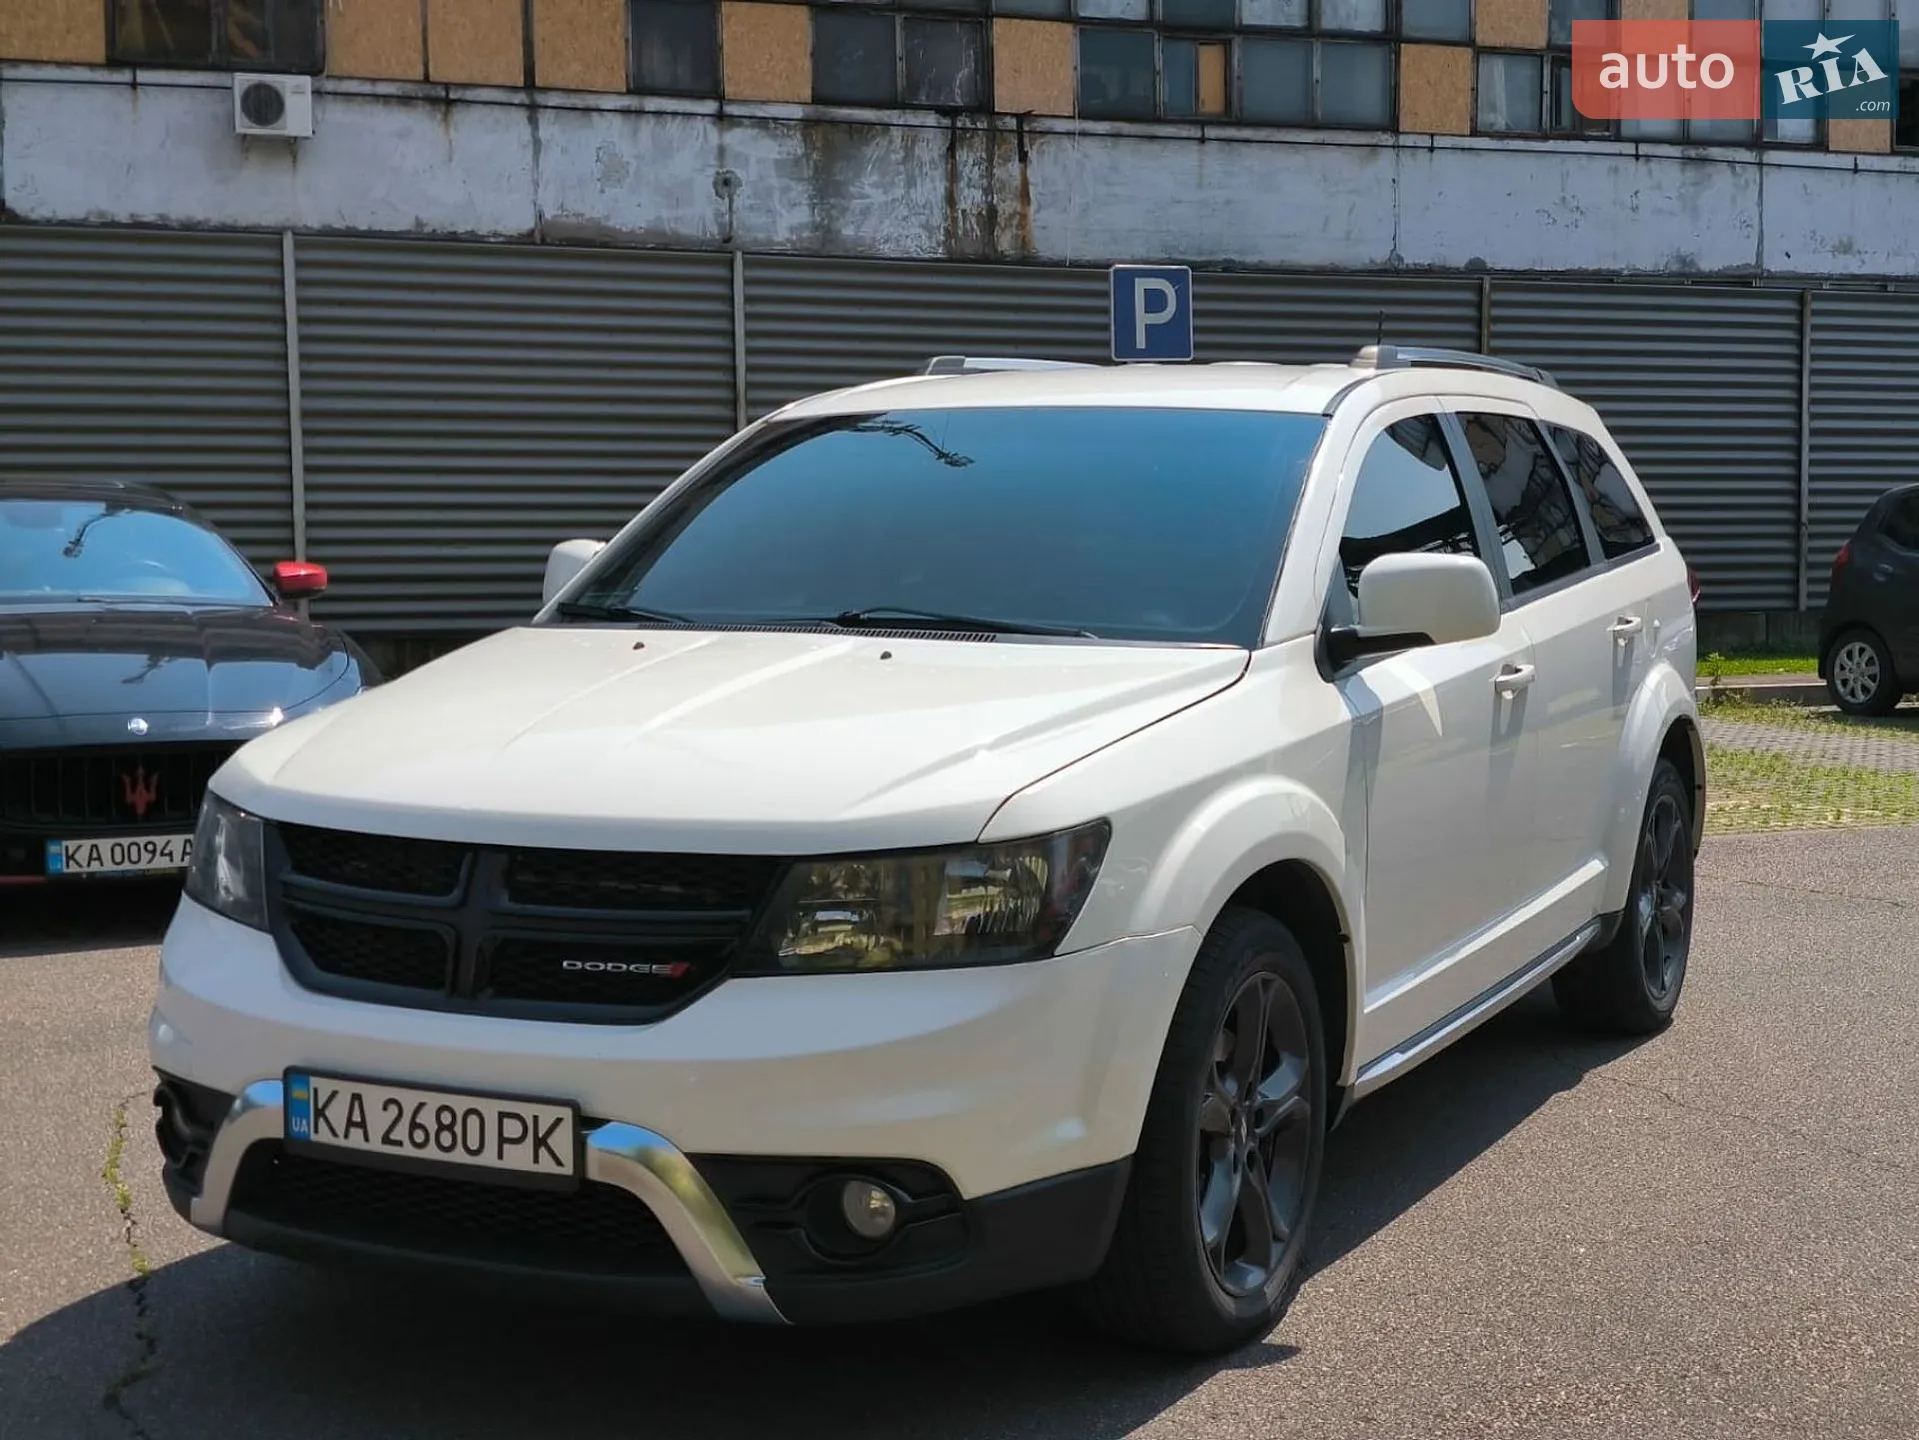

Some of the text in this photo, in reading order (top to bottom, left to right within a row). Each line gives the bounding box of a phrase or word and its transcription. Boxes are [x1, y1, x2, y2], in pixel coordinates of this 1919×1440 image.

[1134, 277, 1177, 349] P
[65, 844, 104, 869] KA
[111, 840, 174, 866] 0094
[562, 960, 673, 975] DODGE
[292, 1116, 309, 1134] UA
[312, 1087, 565, 1168] KA 2680 PK
